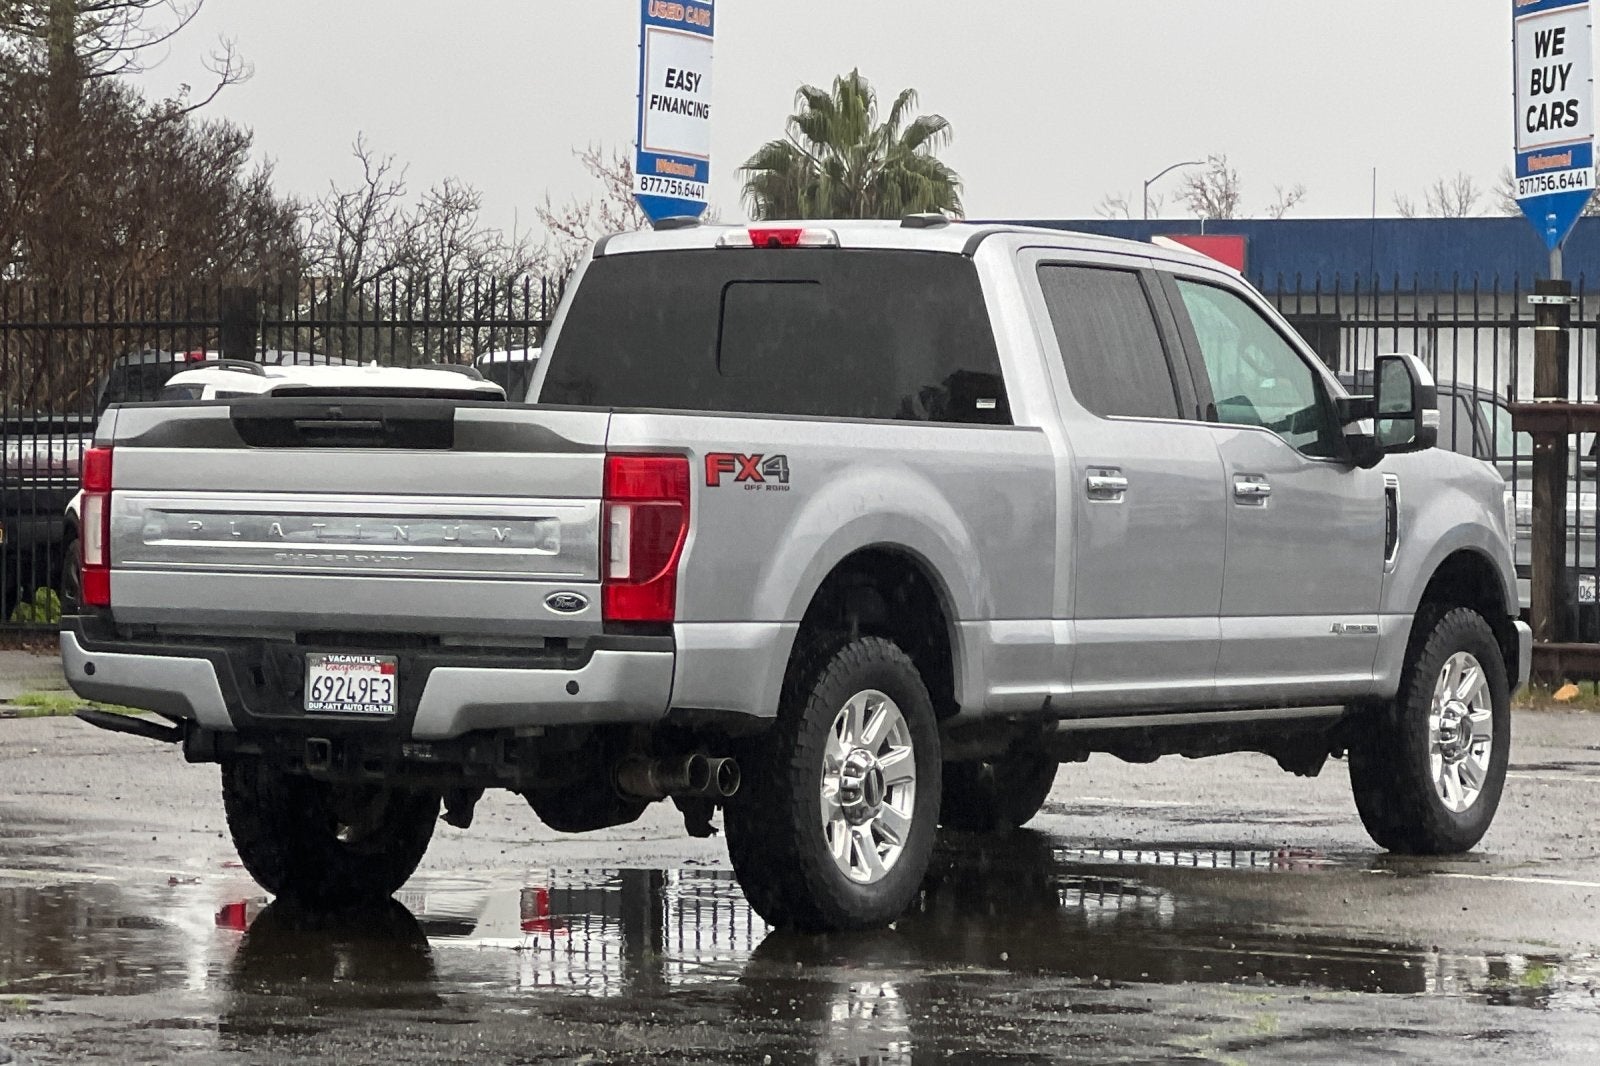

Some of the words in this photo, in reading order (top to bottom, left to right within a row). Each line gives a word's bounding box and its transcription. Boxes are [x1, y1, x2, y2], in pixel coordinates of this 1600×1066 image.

[648, 0, 684, 21] USED
[685, 5, 711, 27] CARS
[1535, 27, 1566, 59] WE
[665, 67, 702, 93] EASY
[1530, 62, 1573, 96] BUY
[649, 94, 709, 119] FINANCING
[1526, 99, 1579, 133] CARS
[640, 177, 705, 199] 877.756.6441
[1519, 171, 1588, 195] 877.756.6441
[705, 452, 789, 487] FX4
[188, 519, 512, 542] PLATINUM
[328, 655, 376, 664] VACAVILLE
[312, 675, 391, 703] 69249E3
[343, 702, 364, 711] AUTO
